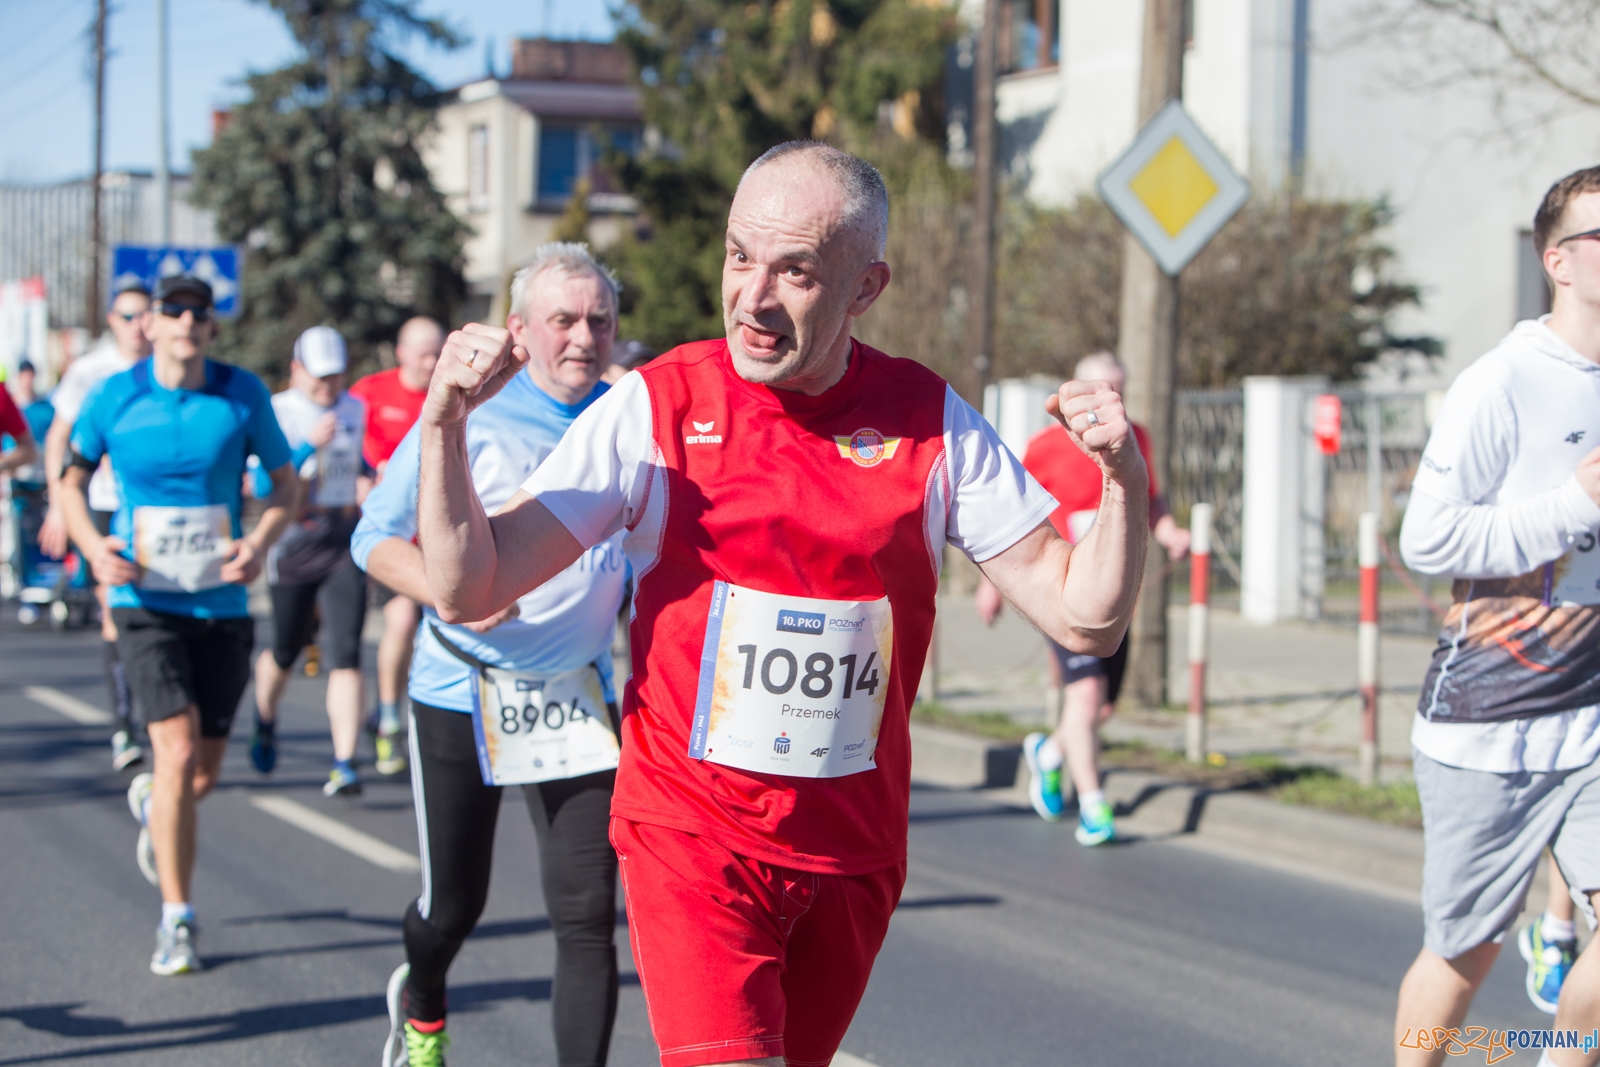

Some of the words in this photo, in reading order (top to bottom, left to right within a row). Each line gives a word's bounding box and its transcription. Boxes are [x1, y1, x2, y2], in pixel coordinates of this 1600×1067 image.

[686, 434, 723, 445] erima
[1564, 430, 1586, 444] 4F
[782, 616, 796, 627] 10.
[797, 617, 822, 629] PKO
[738, 644, 879, 699] 10814
[501, 697, 590, 735] 8904
[781, 704, 841, 720] Przemek
[810, 747, 829, 757] 4F
